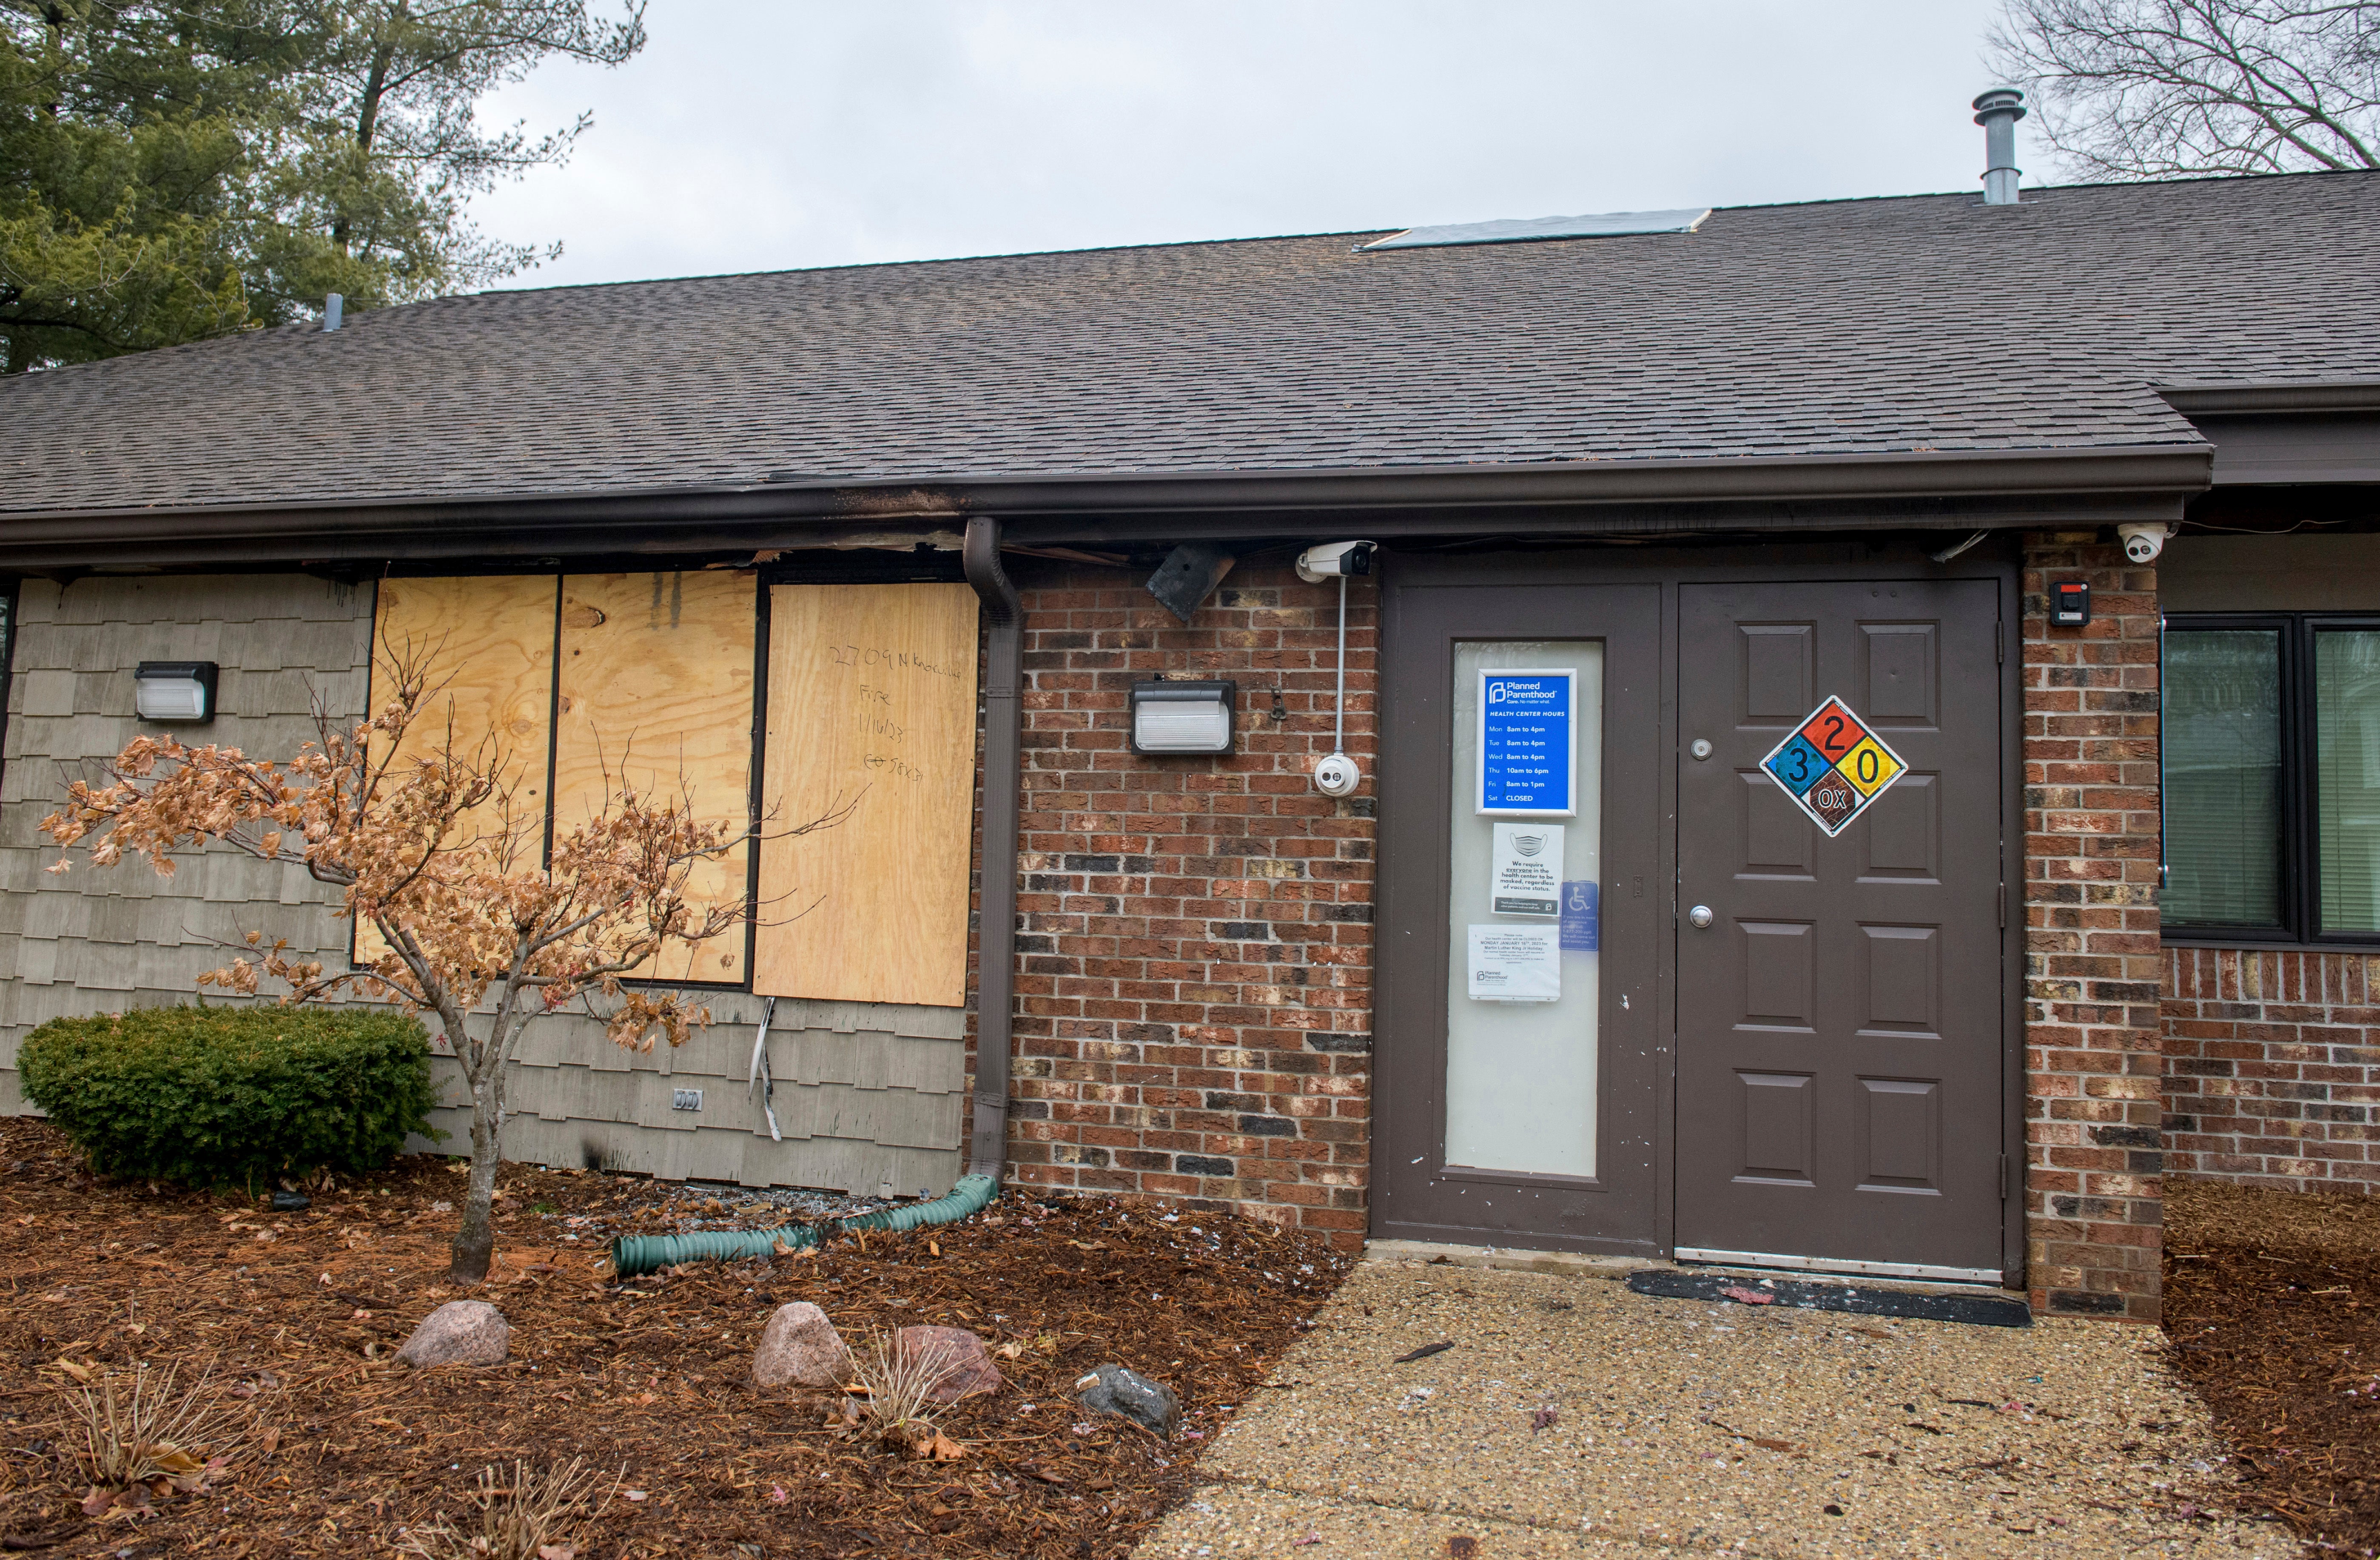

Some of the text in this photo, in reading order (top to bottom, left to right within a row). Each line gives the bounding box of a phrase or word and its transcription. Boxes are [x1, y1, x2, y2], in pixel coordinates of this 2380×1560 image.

[830, 646, 894, 670] 2709
[899, 653, 908, 667] N
[860, 685, 890, 705] Fire
[860, 713, 903, 743] 1/16/23
[1824, 716, 1845, 750] 2
[1788, 748, 1808, 782] 3
[1857, 749, 1879, 783] 0
[1819, 790, 1846, 808] OX
